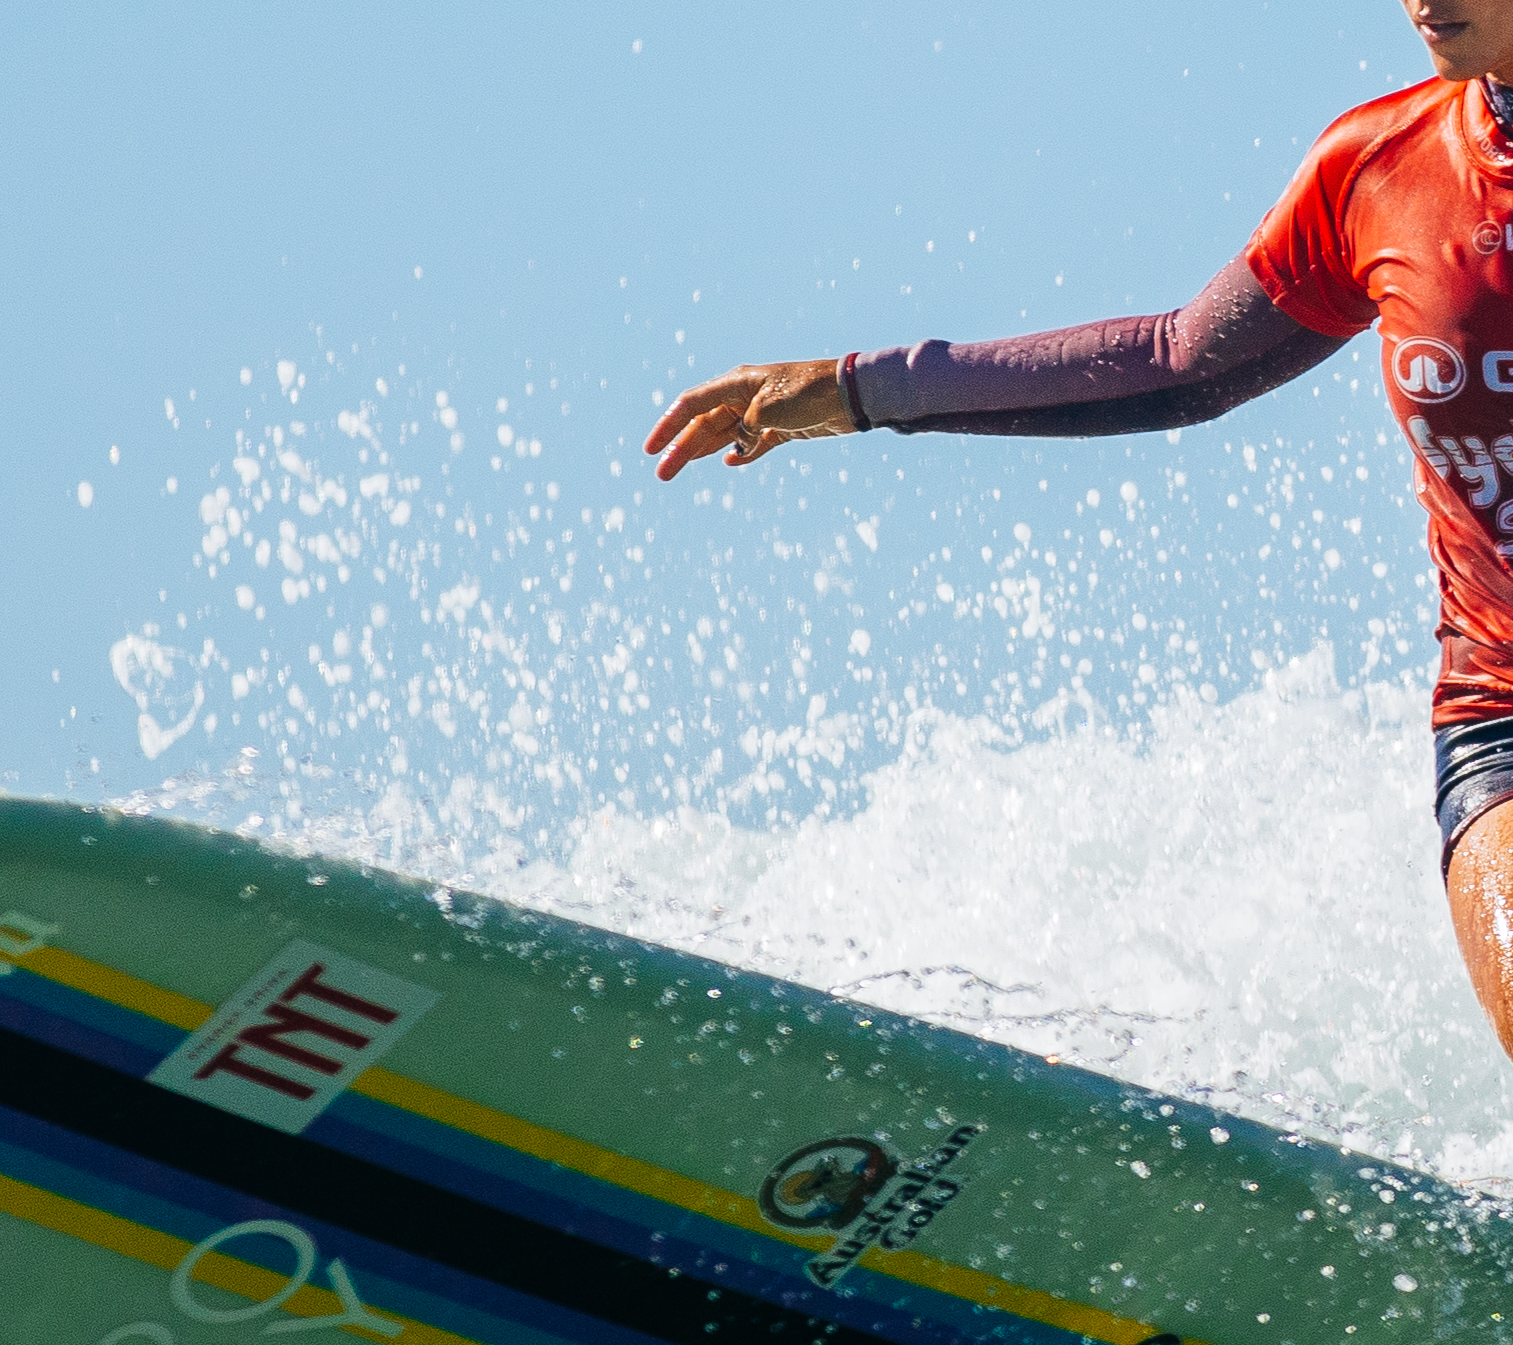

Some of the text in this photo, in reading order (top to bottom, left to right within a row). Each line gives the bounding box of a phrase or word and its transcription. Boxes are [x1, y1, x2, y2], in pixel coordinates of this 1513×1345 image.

[193, 961, 399, 1102] TNT
[807, 1126, 980, 1285] Australian
[880, 1180, 959, 1249] Gold
